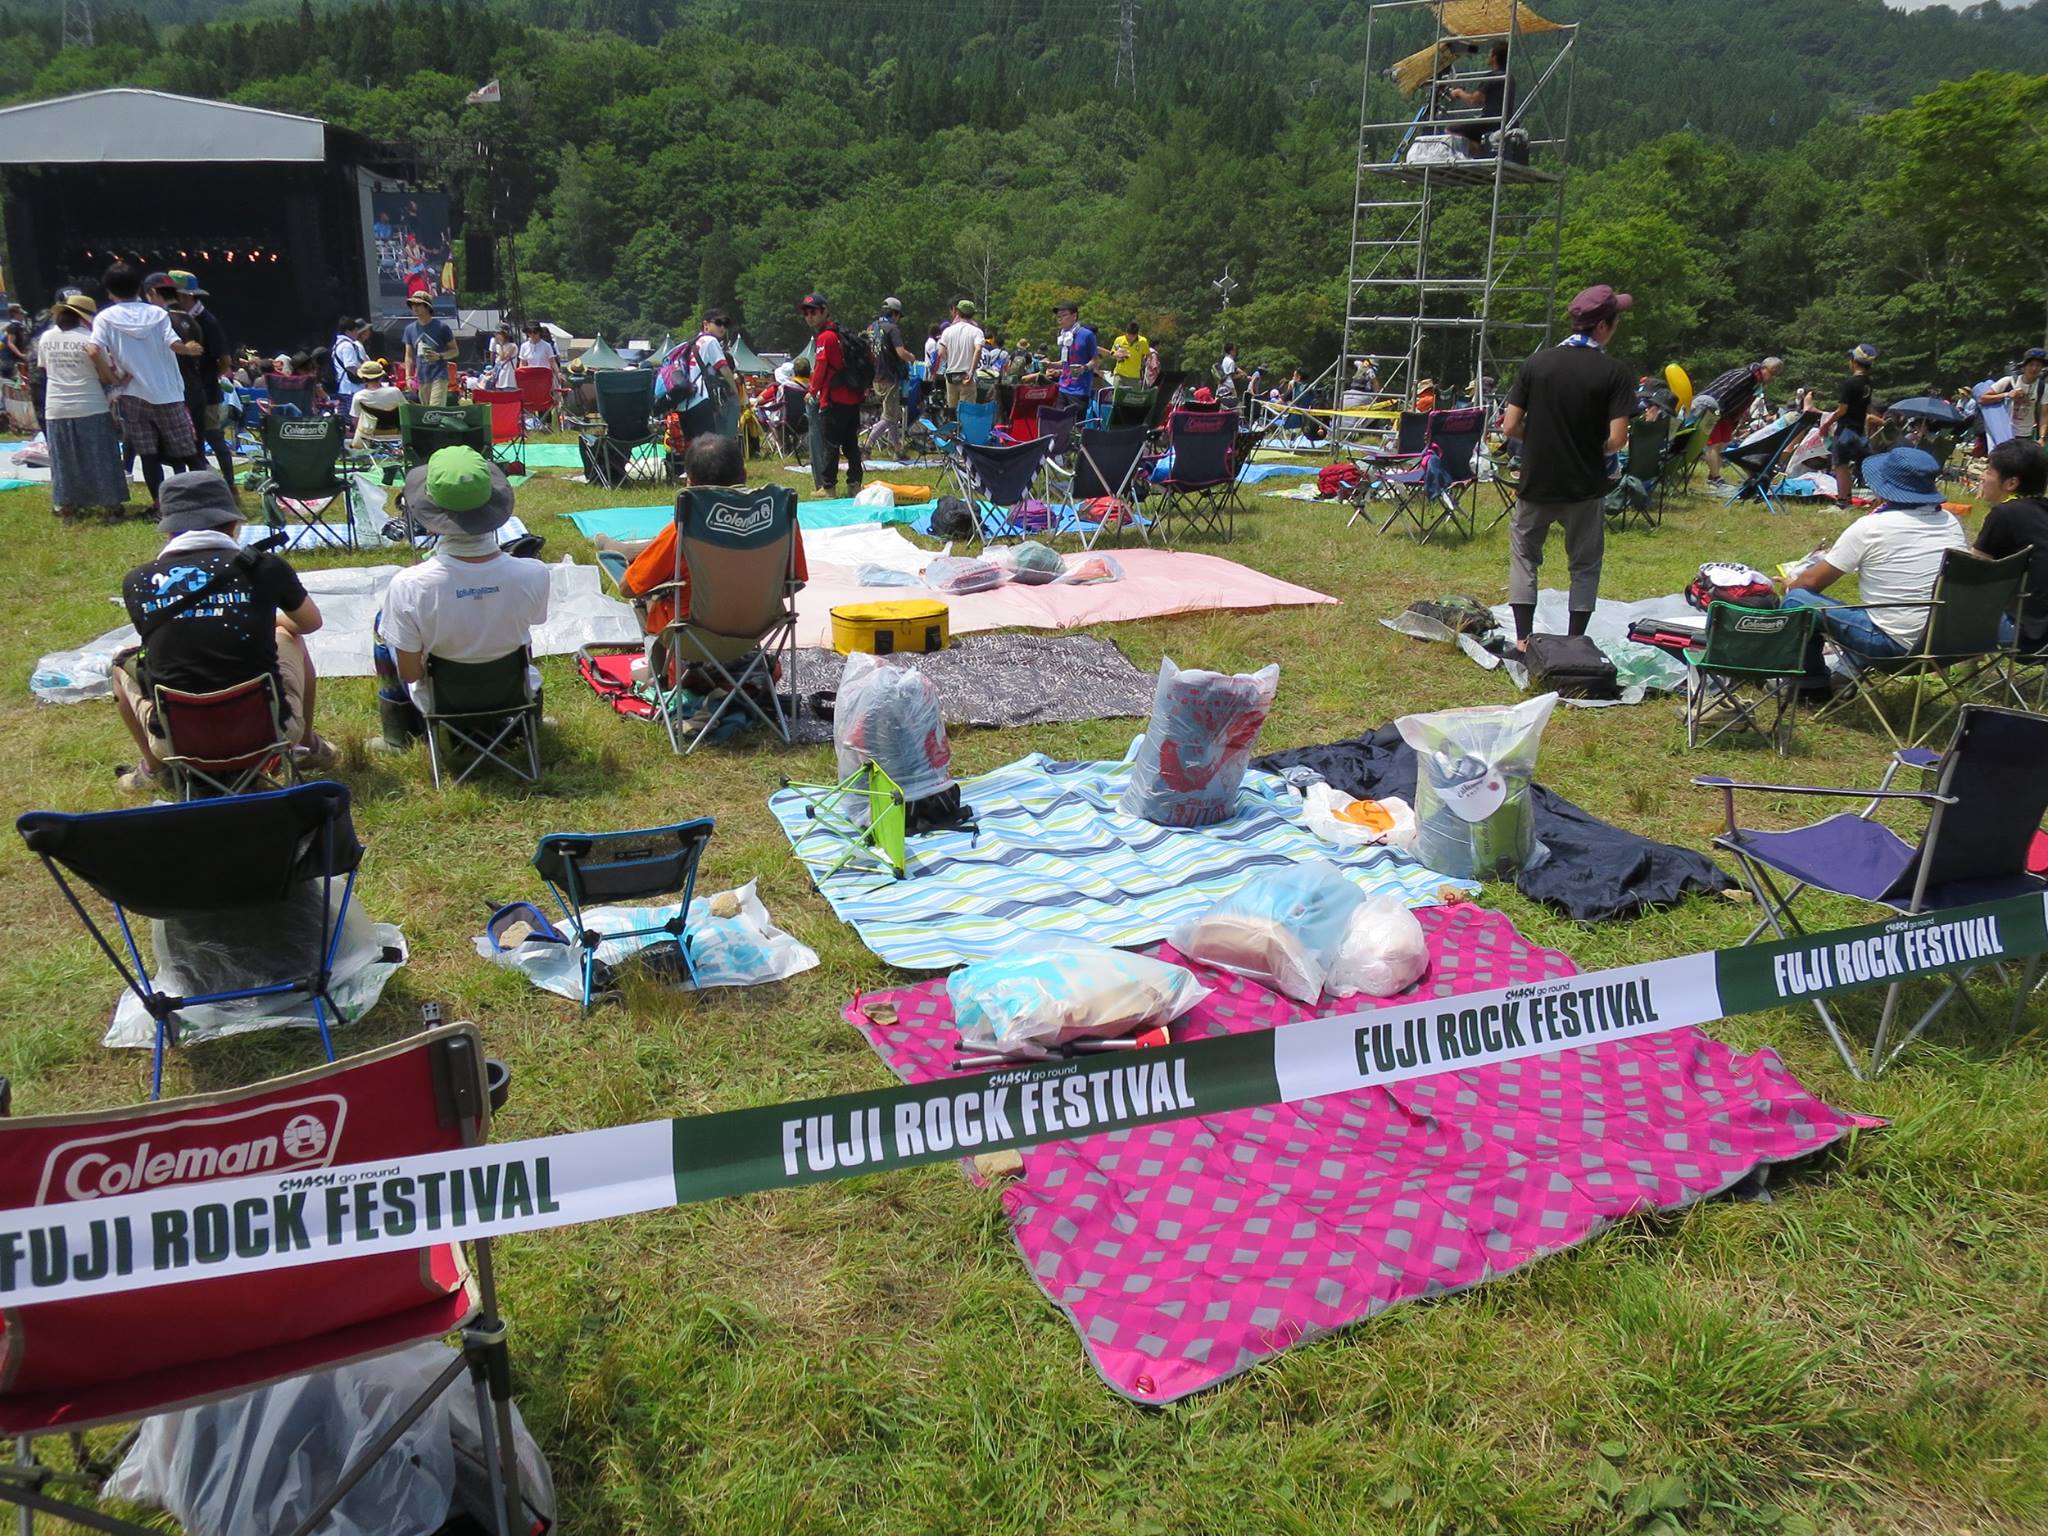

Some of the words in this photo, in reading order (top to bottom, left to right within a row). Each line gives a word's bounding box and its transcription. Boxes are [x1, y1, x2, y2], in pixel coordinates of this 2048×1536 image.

[1774, 946, 1833, 997] FUJI
[1835, 934, 1904, 985] ROCK
[1904, 915, 2004, 971] FESTIVAL
[1884, 920, 1909, 934] SMASH
[1505, 986, 1536, 1001] SMASH
[1537, 988, 1547, 997] go
[1548, 982, 1570, 994] round
[1355, 1017, 1431, 1076] FUJI
[1437, 1001, 1526, 1061] ROCK
[1530, 978, 1659, 1044] FESTIVAL
[988, 1069, 1031, 1089] SMASH
[1032, 1071, 1046, 1082] go
[1047, 1064, 1078, 1078] round
[782, 1107, 884, 1176] FUJI
[895, 1087, 1015, 1157] ROCK
[1021, 1058, 1196, 1137] FESTIVAL
[65, 1136, 278, 1201] Coleman
[278, 1172, 336, 1192] SMASH
[338, 1176, 357, 1186] go
[360, 1166, 401, 1180] round
[0, 1216, 133, 1293] FUJI
[151, 1191, 312, 1271] ROCK
[325, 1156, 560, 1246] FESTIVAL
